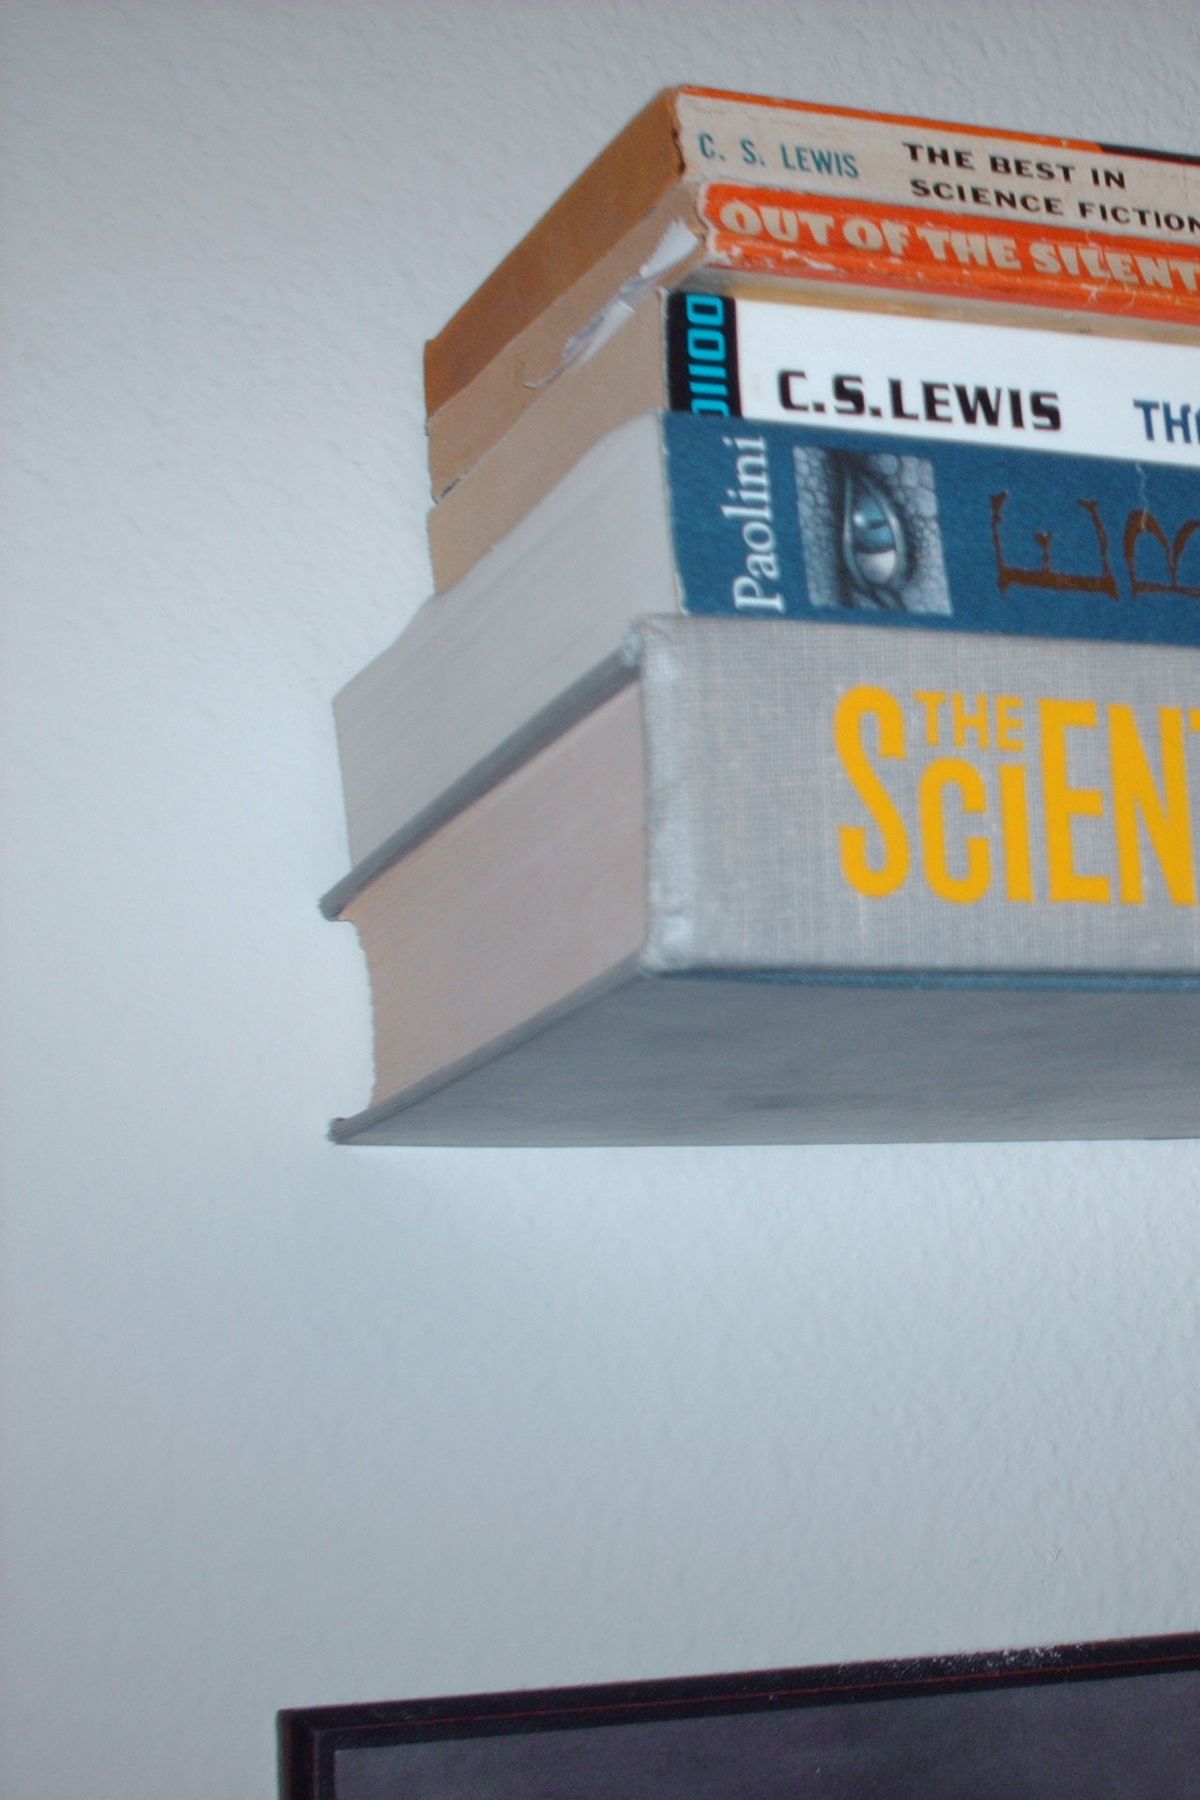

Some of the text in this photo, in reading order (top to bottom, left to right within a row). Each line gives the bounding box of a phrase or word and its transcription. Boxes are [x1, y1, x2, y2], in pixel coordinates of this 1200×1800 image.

[699, 134, 860, 179] C. S. LEWIS
[902, 141, 1127, 190] THE BEST IN
[908, 177, 1065, 217] SCIENCE
[719, 202, 835, 247] OUT
[843, 217, 910, 256] OF
[916, 225, 1022, 270] THE
[1028, 242, 1200, 291] SILENT
[721, 435, 786, 614] Paolini
[916, 690, 1025, 752] THE
